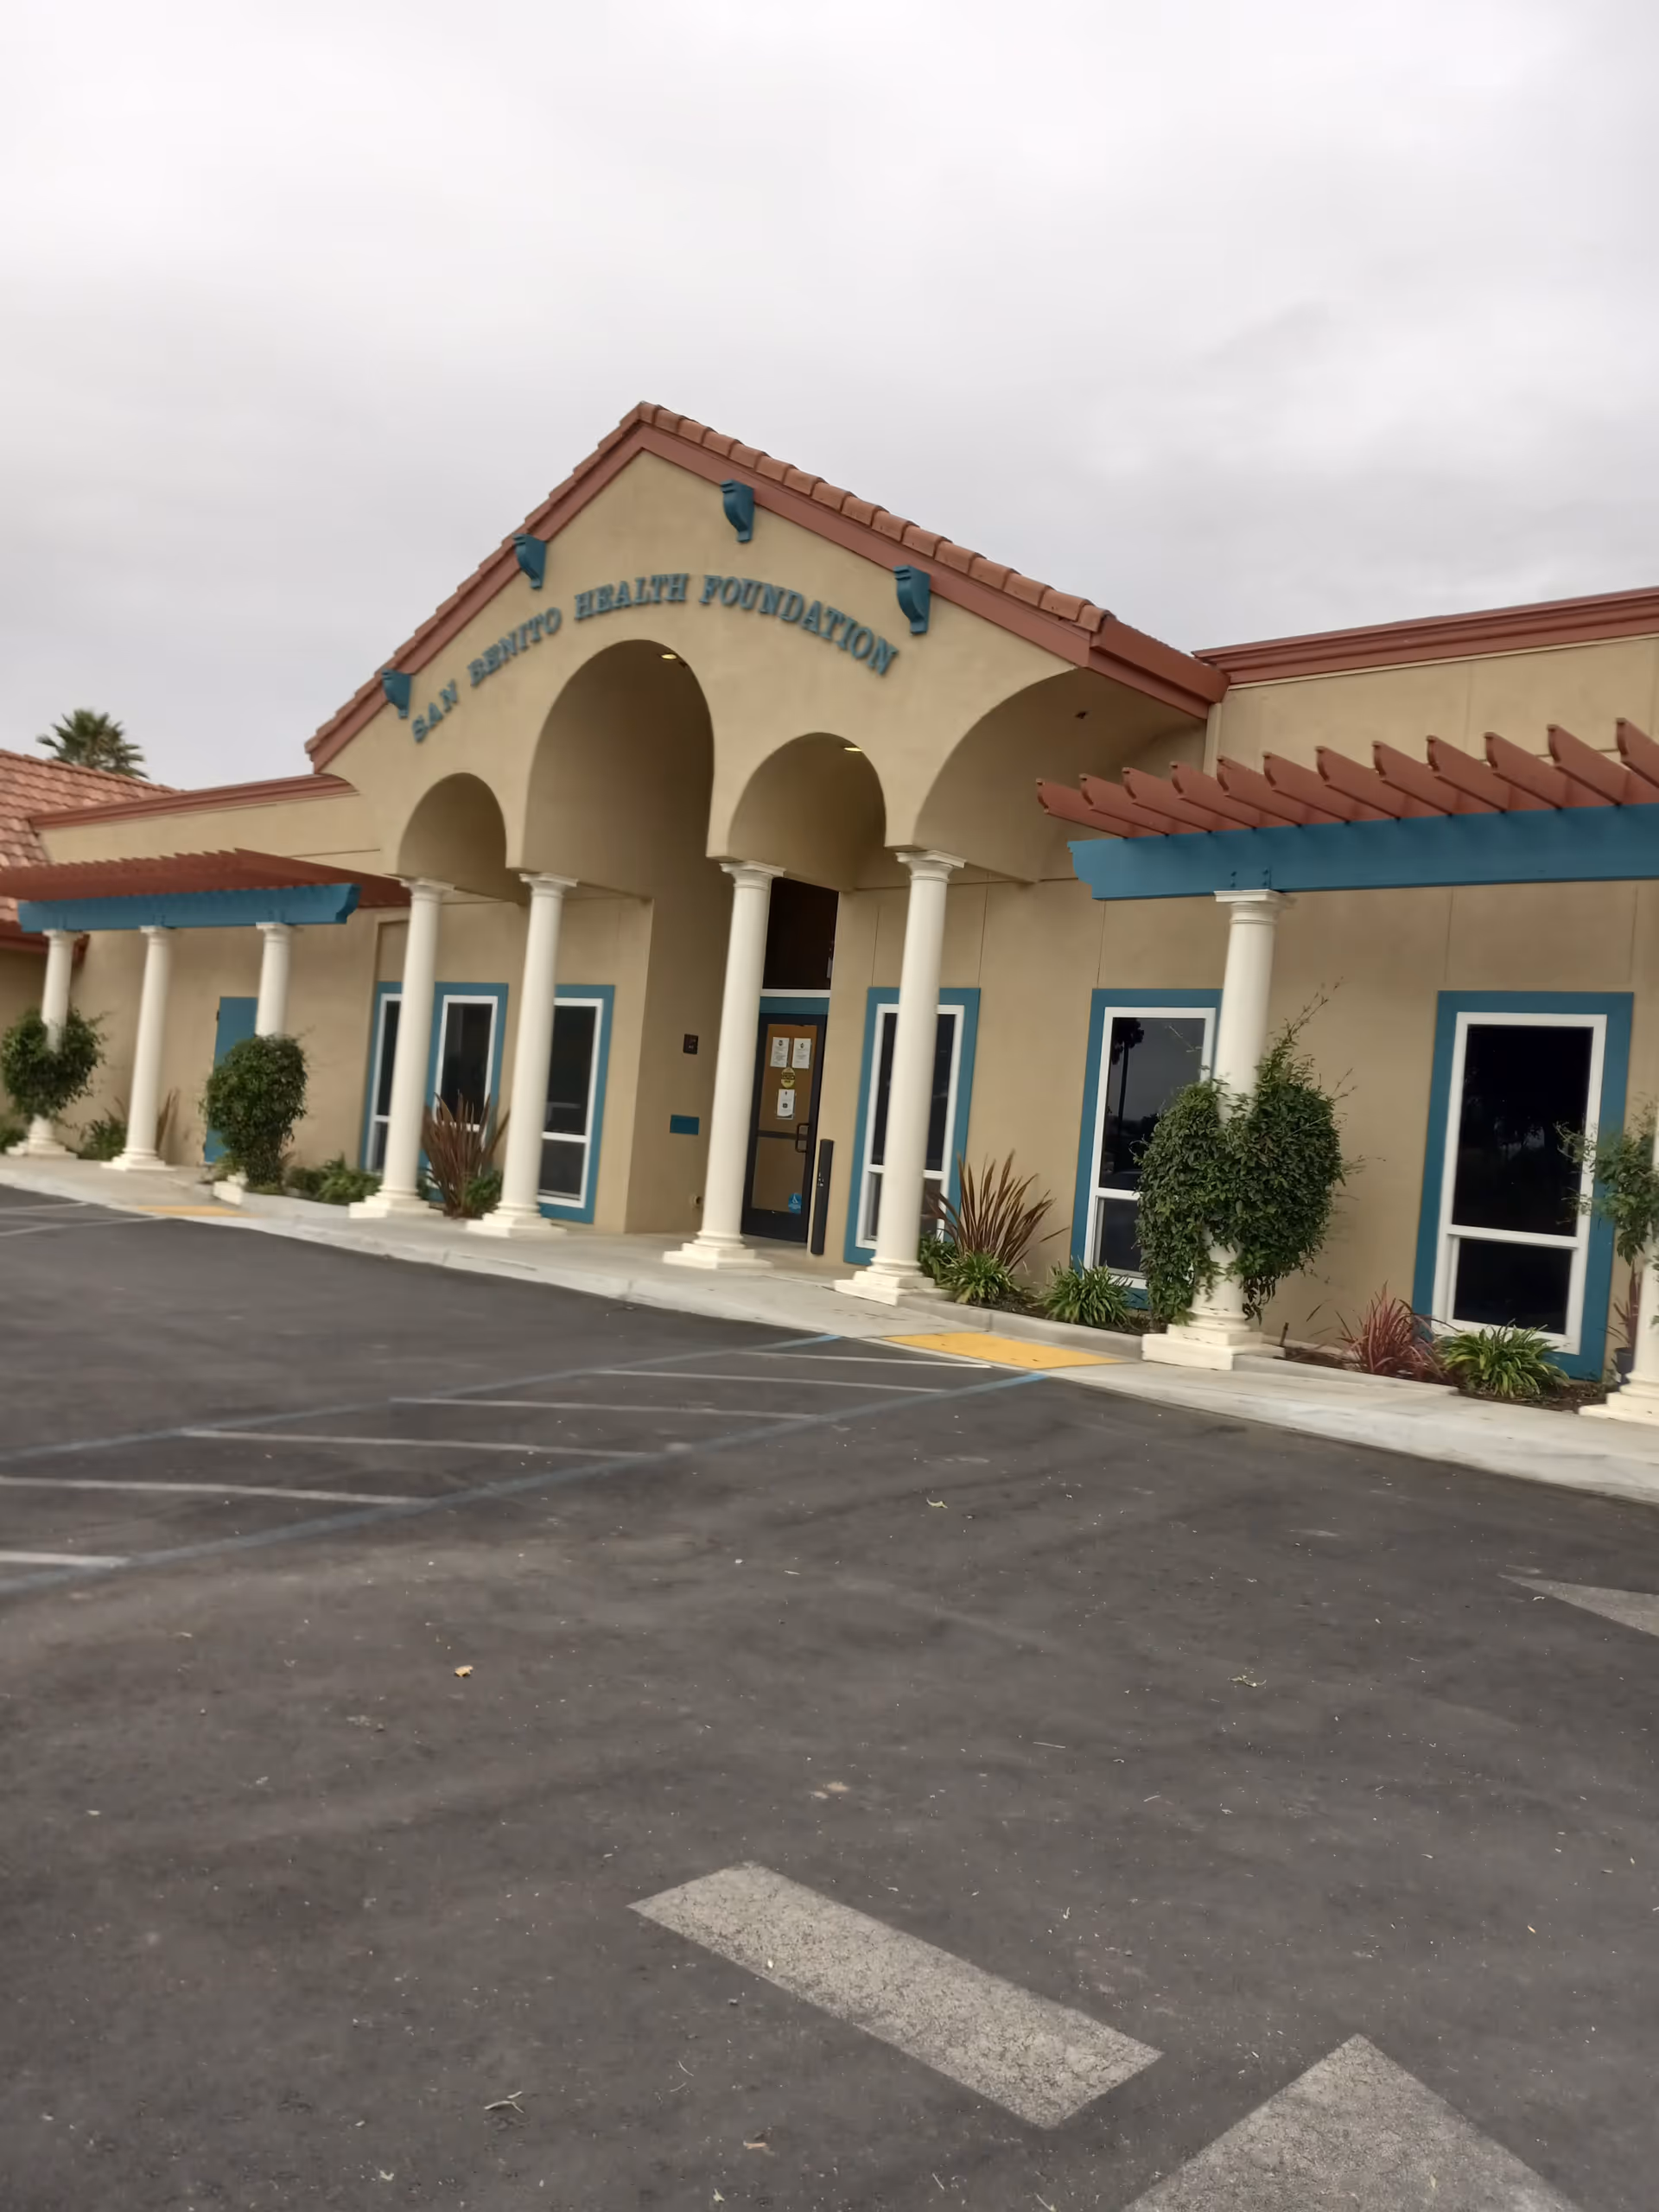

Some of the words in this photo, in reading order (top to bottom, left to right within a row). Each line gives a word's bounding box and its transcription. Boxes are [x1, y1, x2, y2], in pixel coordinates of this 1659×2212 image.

[411, 680, 459, 742] SAN
[467, 607, 562, 686] BENITO
[574, 574, 690, 620] HEALTH
[699, 575, 899, 676] FOUNDATION
